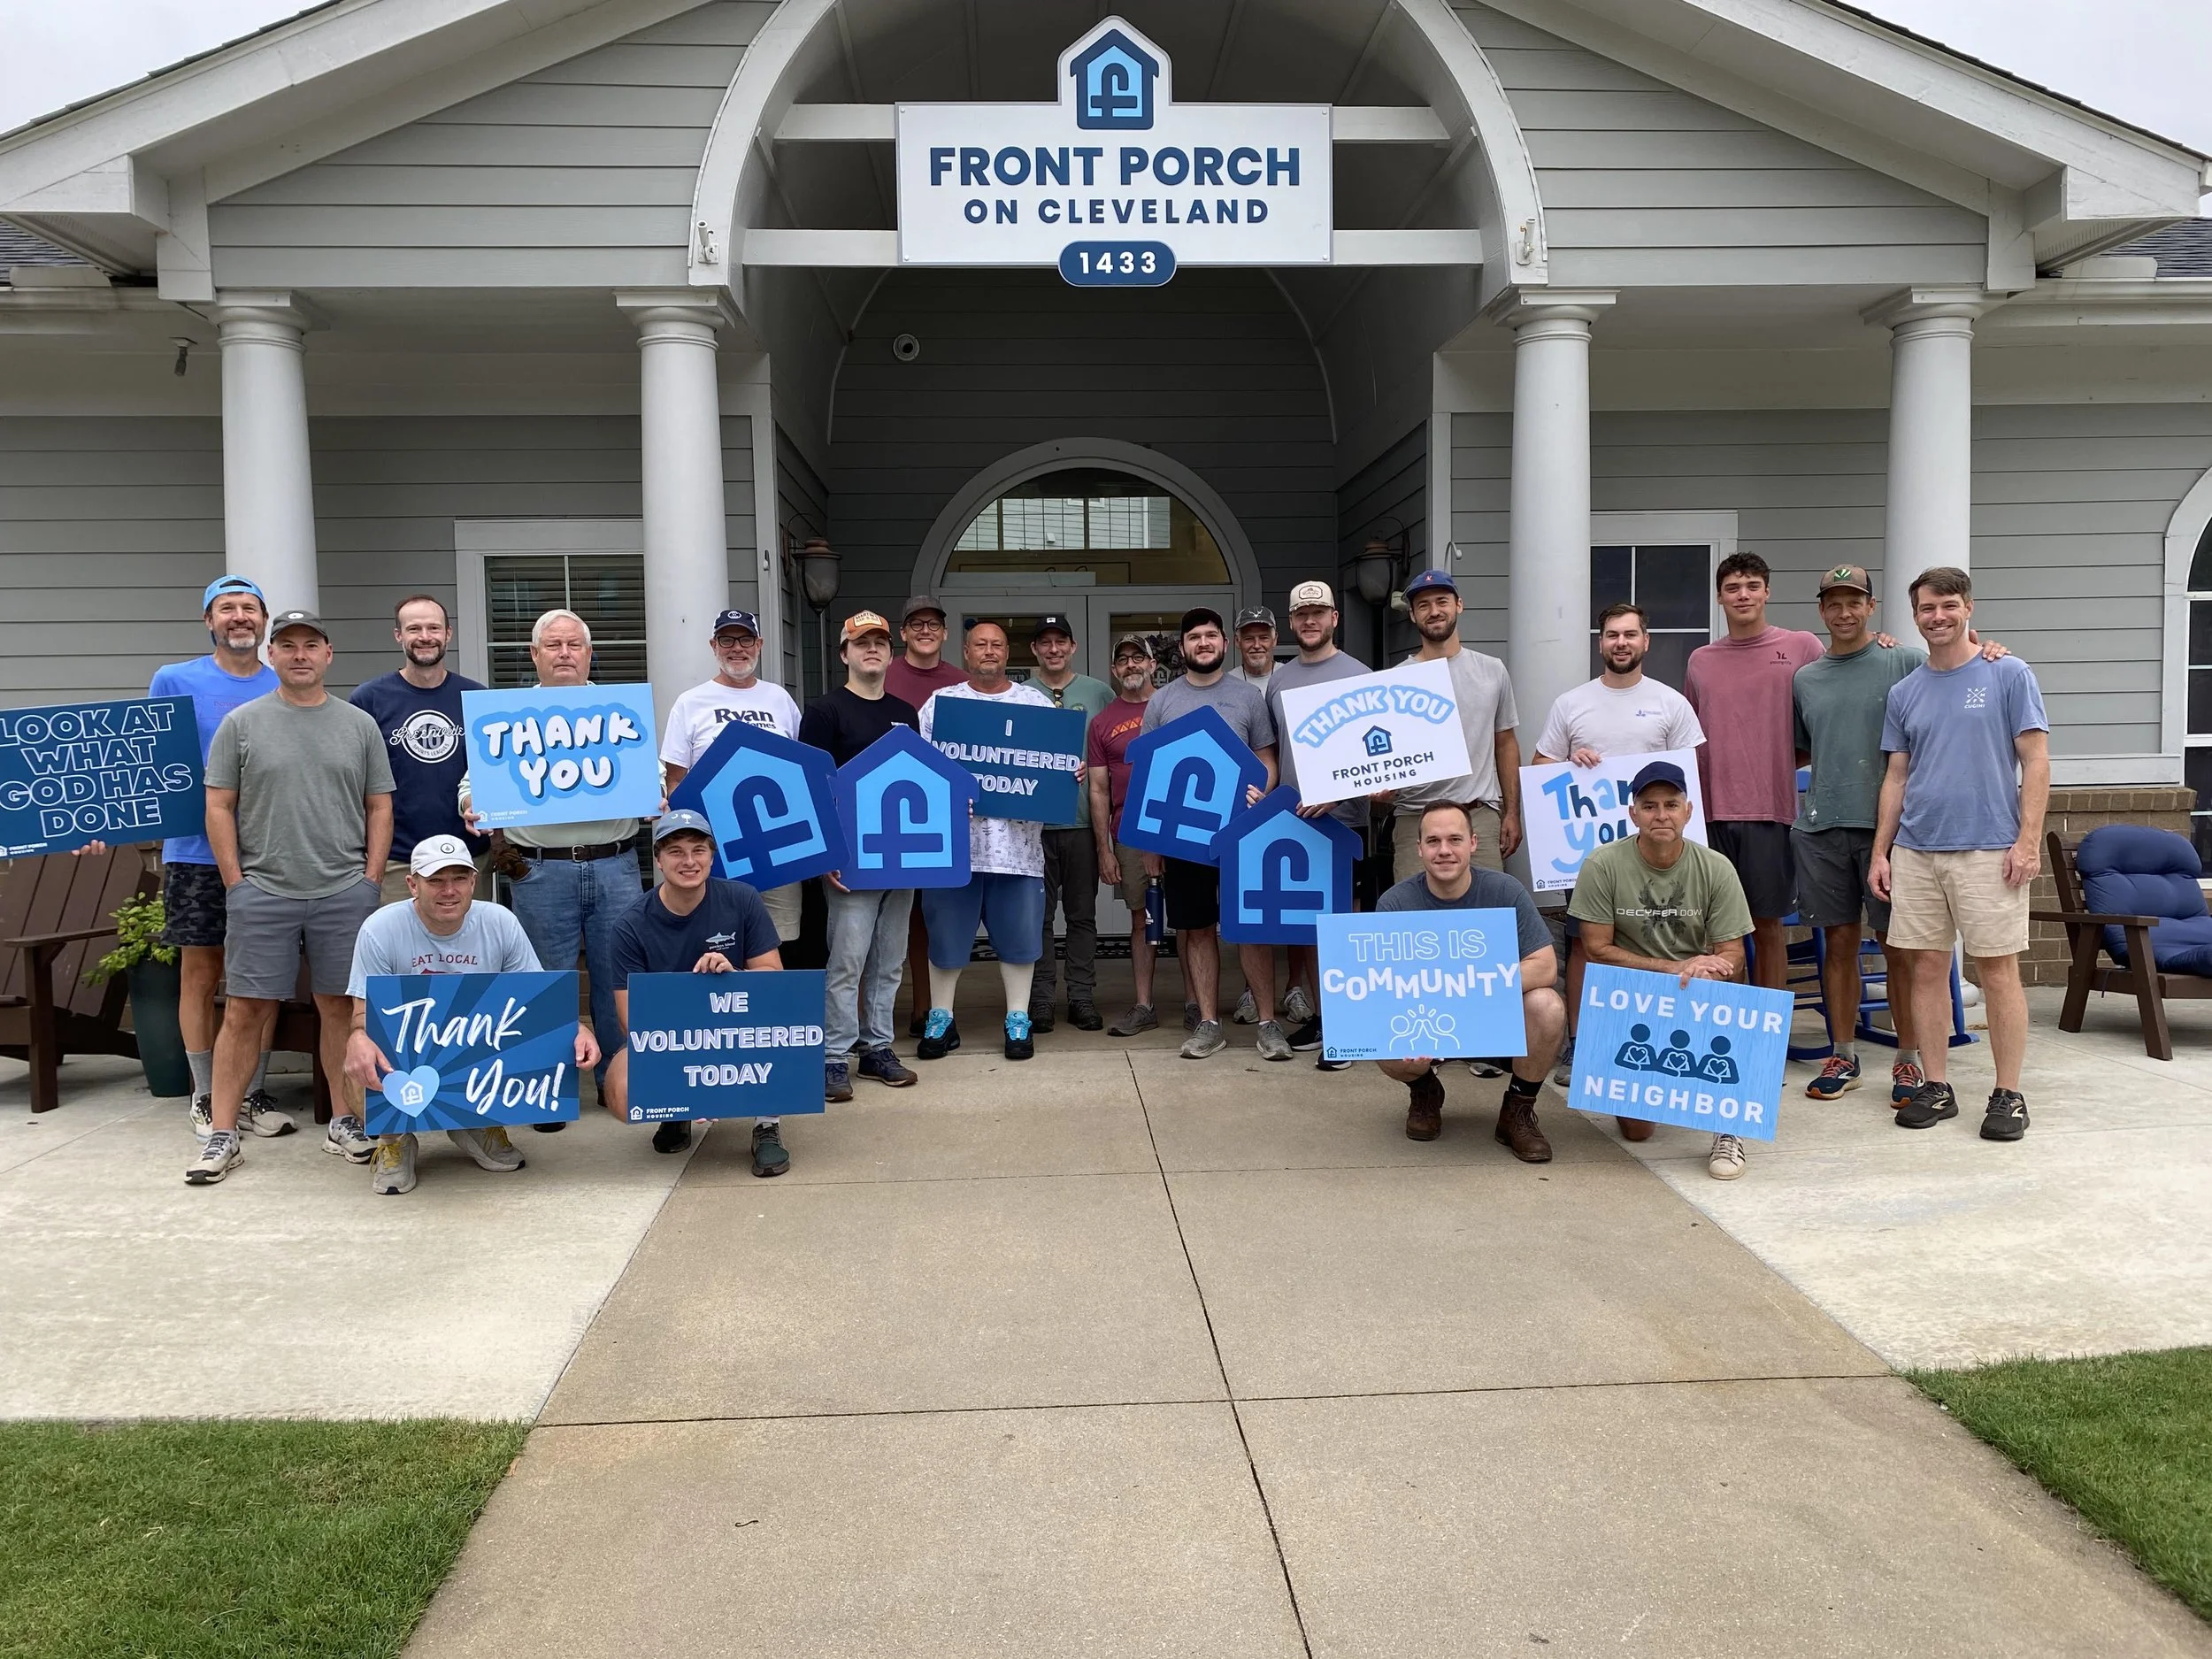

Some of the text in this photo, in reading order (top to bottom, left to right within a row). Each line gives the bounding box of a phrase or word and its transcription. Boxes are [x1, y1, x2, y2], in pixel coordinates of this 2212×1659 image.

[930, 147, 1300, 186] FRONT PORCH
[964, 199, 1268, 224] ON CLEVELAND
[1079, 251, 1156, 273] 1433
[0, 703, 174, 748] LOOK AT
[482, 711, 641, 758] THANK
[714, 708, 774, 724] Ryan
[1004, 719, 1013, 737] I
[1296, 688, 1450, 745] THANK YOU
[21, 736, 157, 776] WHAT
[932, 740, 1080, 772] VOLUNTEERED
[1333, 751, 1434, 780] FRONT PORCH
[0, 764, 193, 810] GOD HAS
[519, 756, 614, 798] YOU
[1354, 769, 1417, 787] HOUSING
[1541, 772, 1634, 820] Than
[40, 797, 162, 838] DONE
[412, 953, 478, 967] EAT LOCAL
[1348, 929, 1487, 962] THIS IS
[1323, 963, 1520, 1001] COMMUNITY
[710, 992, 749, 1013] WE
[1589, 986, 1784, 1034] LOVE YOUR
[381, 997, 527, 1055] Thank
[630, 1025, 824, 1053] VOLUNTEERED
[465, 1058, 565, 1115] You!
[684, 1063, 772, 1087] TODAY
[1584, 1075, 1763, 1124] NEIGHBOR
